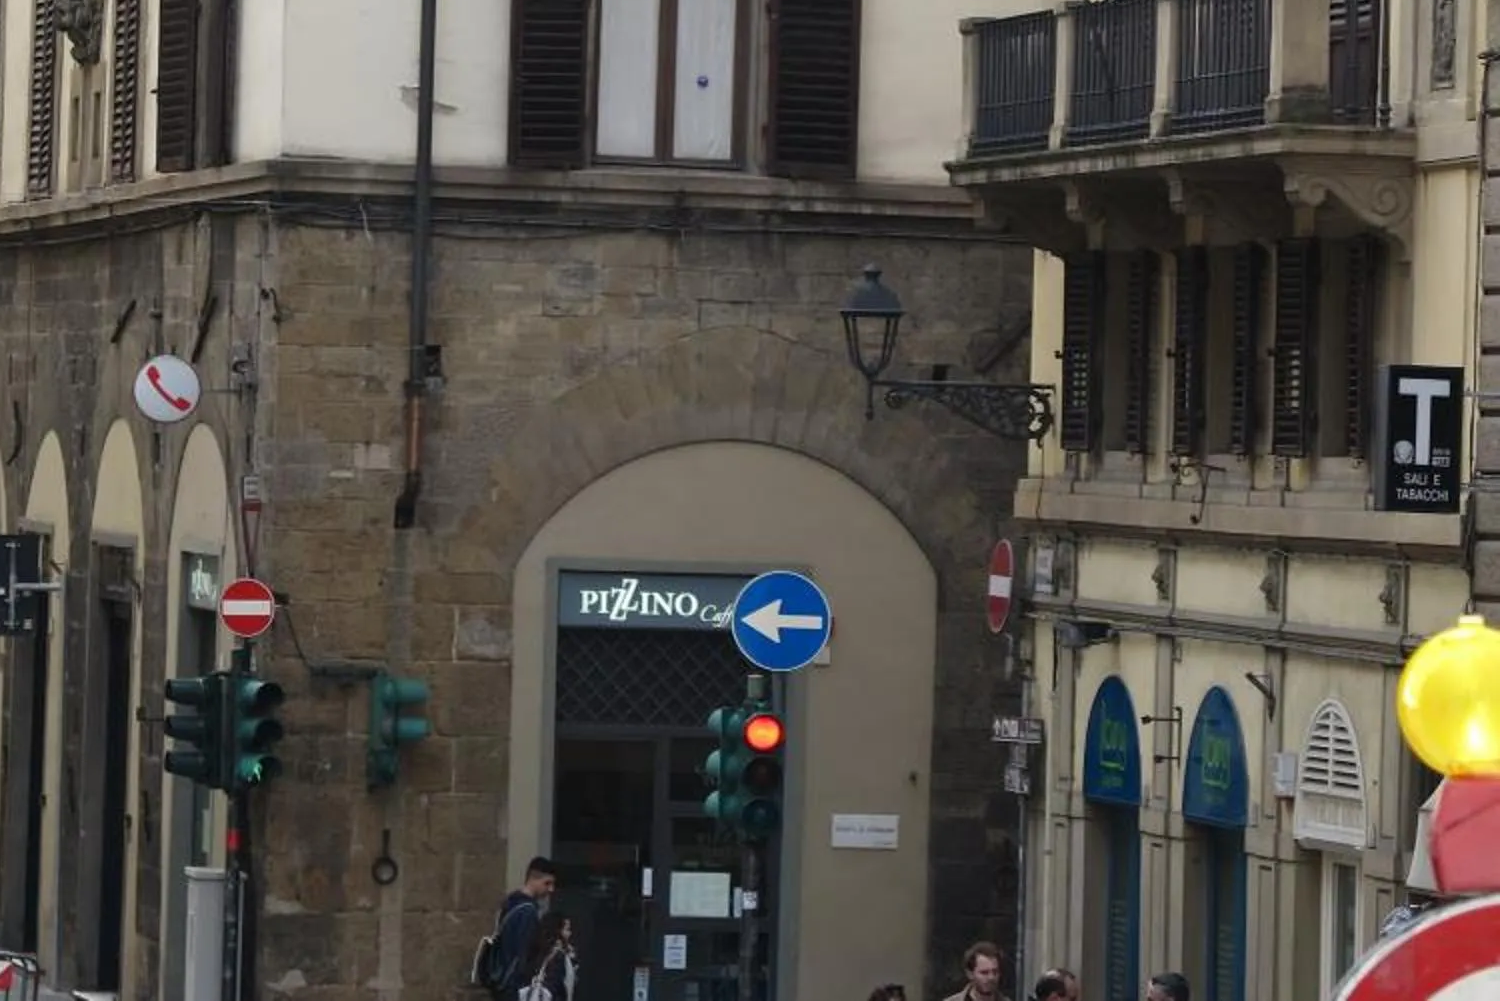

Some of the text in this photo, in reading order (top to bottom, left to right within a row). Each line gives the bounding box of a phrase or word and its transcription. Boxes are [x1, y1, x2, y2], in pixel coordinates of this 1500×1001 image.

[1399, 378, 1450, 465] T
[1396, 488, 1449, 502] TABACCHI
[1403, 472, 1441, 486] SALI E
[579, 578, 734, 628] PIZZINO Caff
